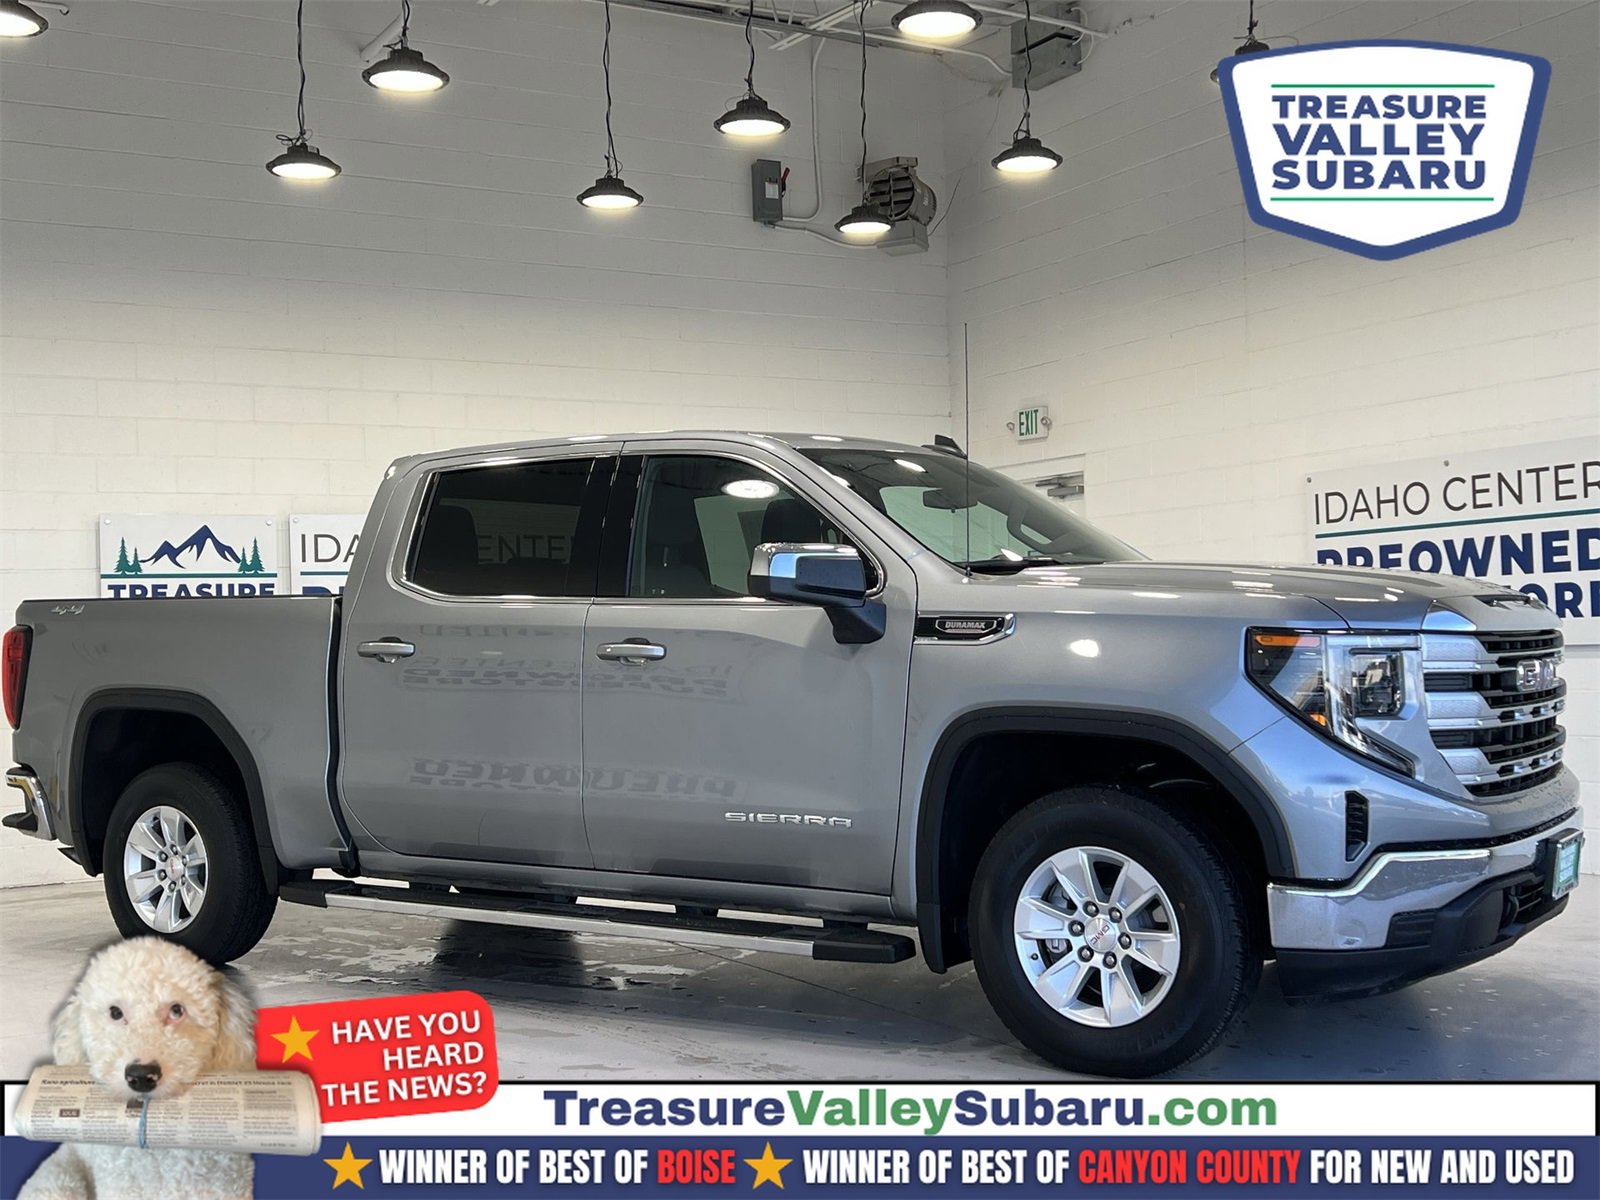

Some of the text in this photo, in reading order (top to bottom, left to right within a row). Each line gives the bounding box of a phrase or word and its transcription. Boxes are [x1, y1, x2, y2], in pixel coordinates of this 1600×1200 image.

[1019, 409, 1039, 436] EXIT
[1314, 461, 1600, 525] IDAHO CENTER
[301, 533, 360, 563] IDA
[476, 534, 574, 563] ENTE
[945, 621, 985, 629] DURAMAX
[725, 812, 852, 828] SIERRA
[1090, 924, 1110, 945] GMC
